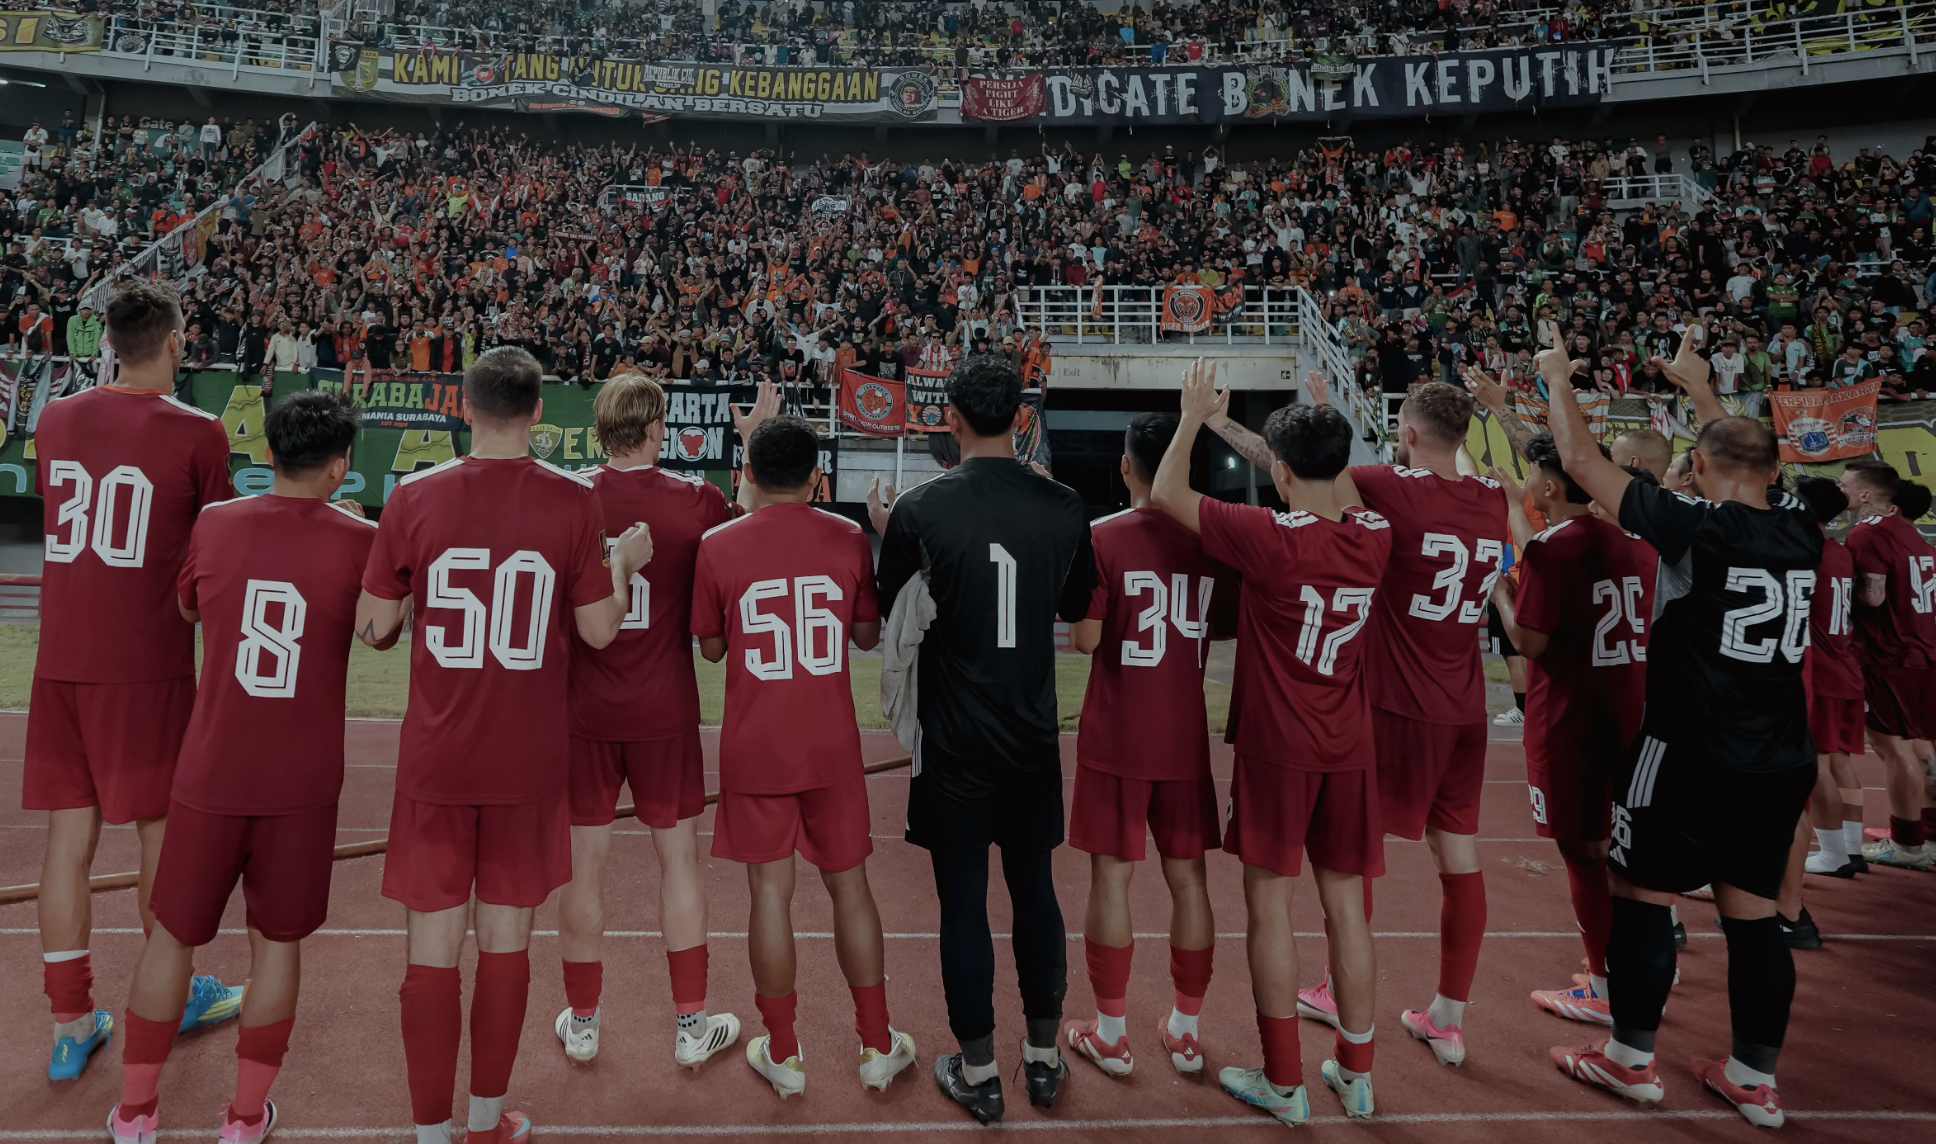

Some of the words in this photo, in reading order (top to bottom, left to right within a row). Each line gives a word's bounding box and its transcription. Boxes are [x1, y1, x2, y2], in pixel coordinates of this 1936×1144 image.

[394, 52, 458, 85] KAMI
[729, 69, 879, 101] KEBANGGAAN
[979, 80, 1024, 90] PERSIJA
[985, 89, 1019, 99] FIGHT
[1222, 63, 1379, 116] BNEK
[1404, 49, 1615, 107] KEPUTIH
[451, 82, 546, 102] BONEK
[694, 98, 823, 118] BERSATU
[982, 108, 989, 116] A
[990, 107, 1025, 117] TIGER
[988, 98, 1014, 108] LIKE
[139, 116, 174, 130] Gate
[907, 374, 948, 388] ALWA
[1063, 368, 1080, 377] Exit
[664, 392, 731, 424] ARTA
[1773, 394, 1823, 408] PERSIJA
[1824, 381, 1882, 405] JAKARTA
[361, 411, 394, 421] MANIA
[396, 411, 447, 423] SURABAYA
[45, 459, 154, 568] 30
[426, 547, 556, 670] 50
[988, 542, 1017, 648] 1
[739, 574, 844, 681] 56
[1121, 570, 1214, 668] 34
[1295, 584, 1376, 676] 17
[234, 578, 307, 698] 8
[1528, 783, 1548, 825] 9
